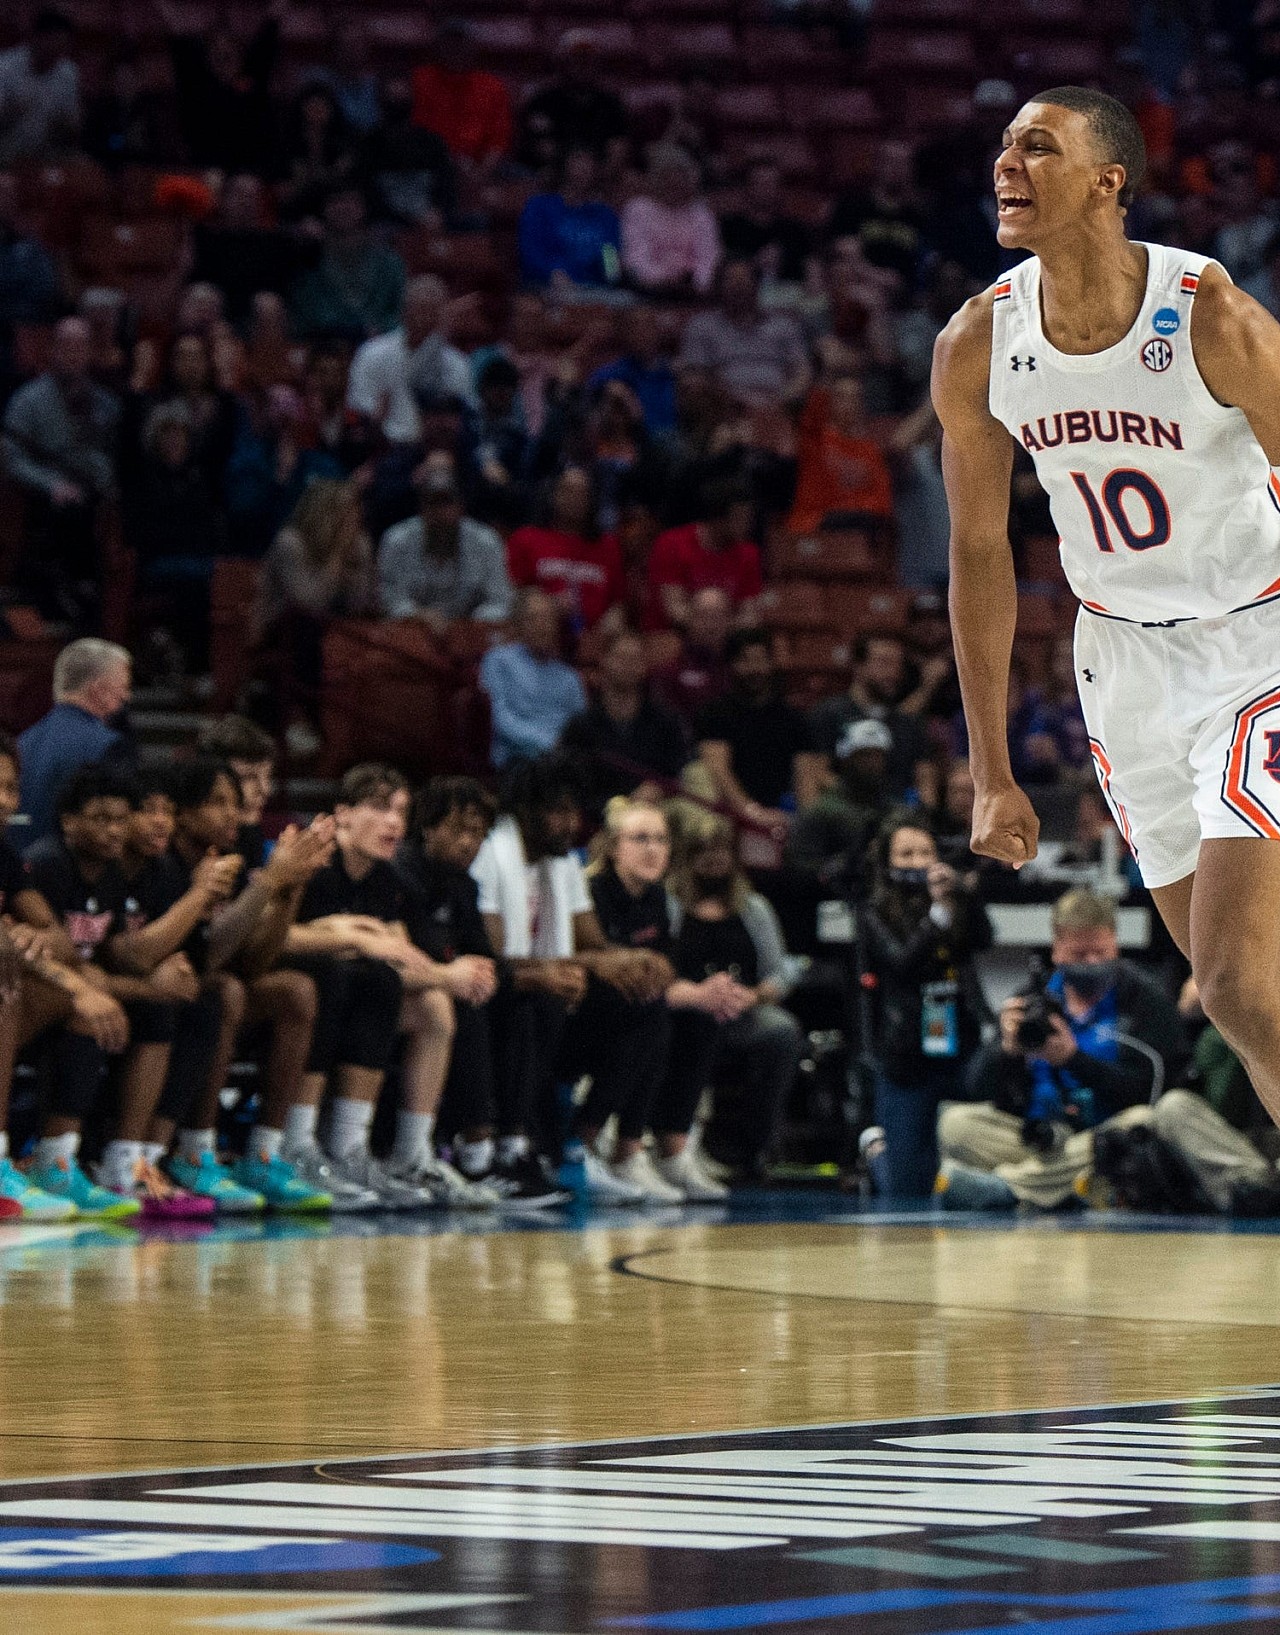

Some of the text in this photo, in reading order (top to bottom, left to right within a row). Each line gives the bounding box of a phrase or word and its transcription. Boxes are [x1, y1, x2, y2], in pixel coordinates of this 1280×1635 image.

[1156, 320, 1177, 328] NCAA
[1143, 340, 1171, 370] SEC
[1020, 410, 1184, 451] AUBURN
[1069, 468, 1171, 553] 10
[0, 1531, 346, 1569] CAA
